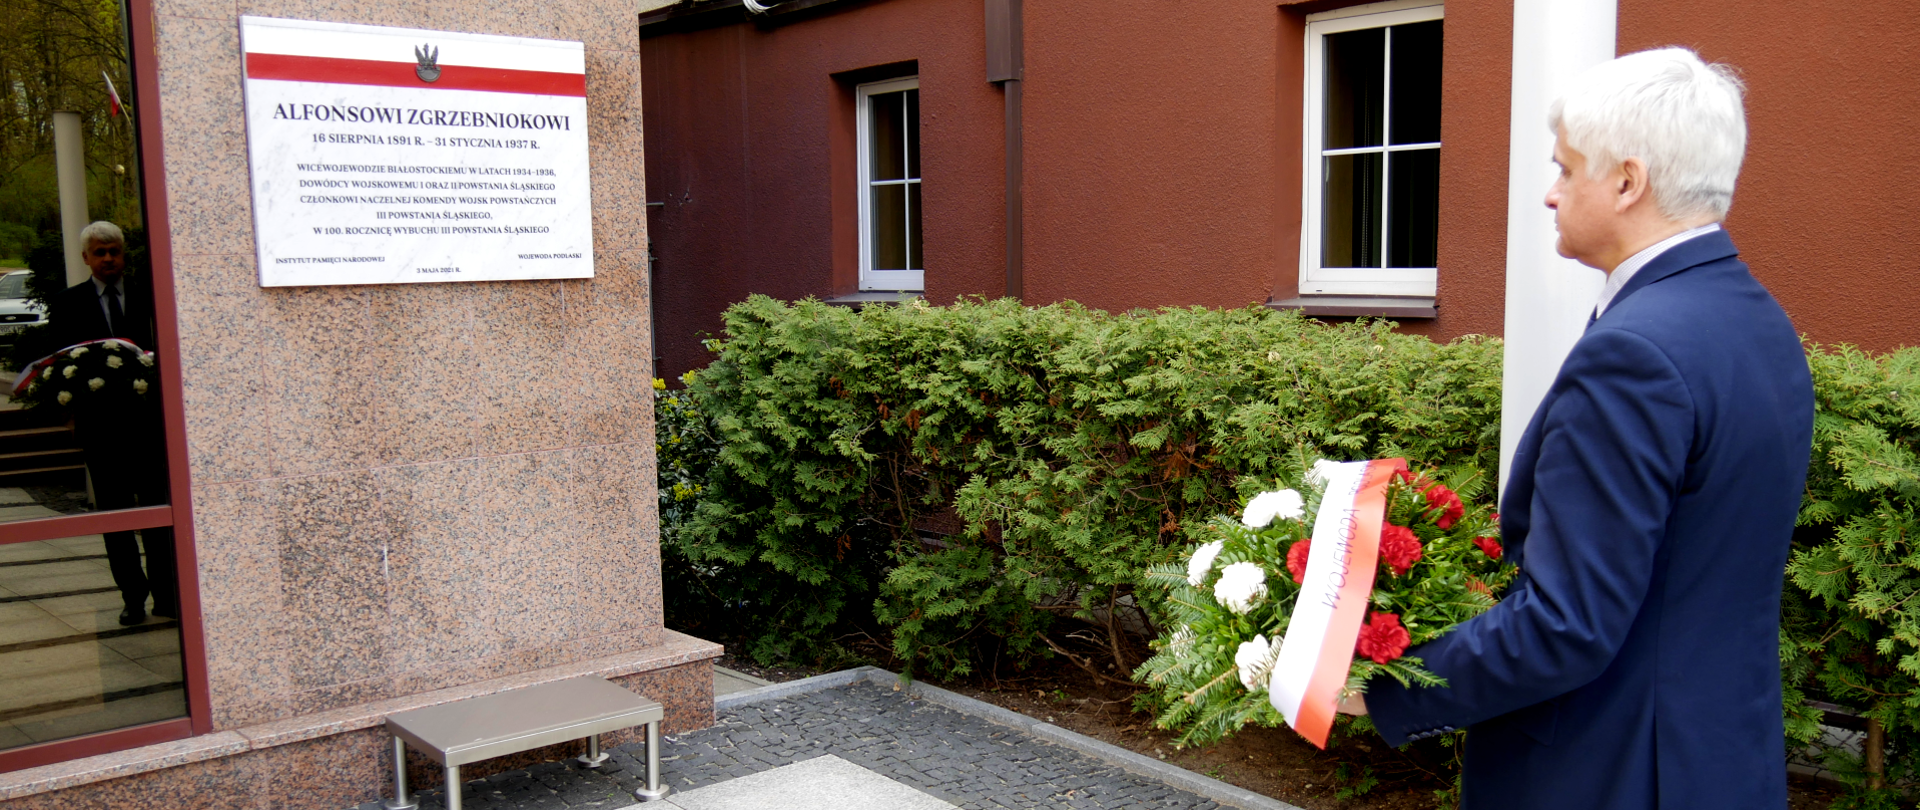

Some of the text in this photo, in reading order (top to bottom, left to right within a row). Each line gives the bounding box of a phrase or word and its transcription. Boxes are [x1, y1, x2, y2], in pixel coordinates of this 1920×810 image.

[273, 103, 570, 131] ALFONSOWI ZGRZEBNIOKOWI
[313, 133, 326, 143] 16
[328, 133, 384, 144] SIERPNIA
[388, 136, 411, 146] 1891
[414, 136, 425, 146] R.
[435, 137, 446, 146] 31
[450, 138, 502, 148] STYCZNIA
[505, 140, 528, 149] 1937
[530, 140, 540, 150] R.
[297, 163, 386, 173] WICEWOJEWODZIE
[388, 165, 467, 175] BIAŁOSTOCKIEMU
[468, 167, 478, 175] W
[478, 167, 510, 176] LATACH
[299, 178, 350, 188] DOWÓDCY
[352, 180, 418, 189] WOJSKOWEMU
[420, 181, 424, 189] I
[425, 182, 449, 190] ORAZ
[458, 182, 508, 190] POWSTANIA
[510, 182, 556, 192] ŚLĄSKIEGO
[300, 195, 556, 205] CZŁONKOWI NACZELNEJ KOMENDY WOJSK POWSTAŃCZYCH
[376, 210, 493, 221] III POWSTANIA ŚLĄSKIEGO,
[313, 226, 322, 234] W
[325, 226, 344, 234] 100.
[345, 226, 392, 236] ROCZNICĘ
[394, 226, 440, 234] WYBUCHU
[452, 226, 502, 234] POWSTANIA
[504, 225, 550, 236] ŚLĄSKIEGO
[1322, 508, 1360, 610] WOJEWODA
